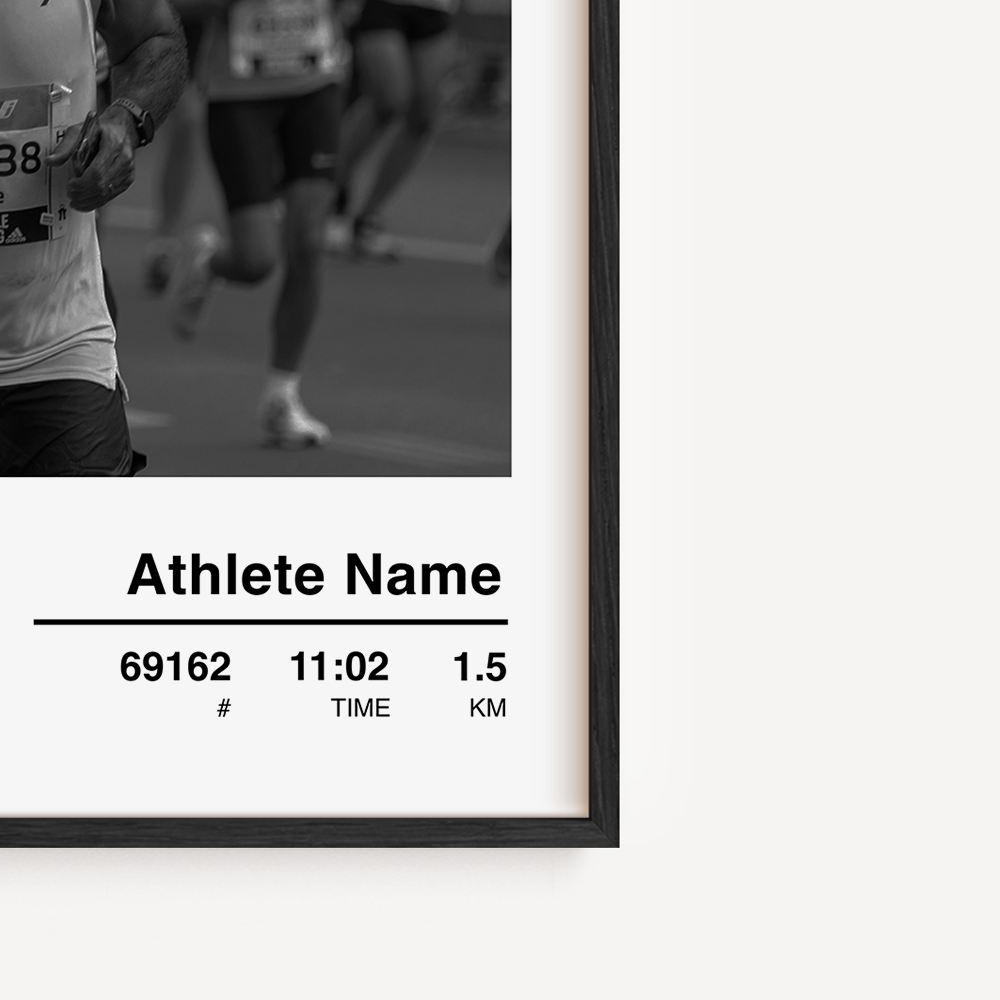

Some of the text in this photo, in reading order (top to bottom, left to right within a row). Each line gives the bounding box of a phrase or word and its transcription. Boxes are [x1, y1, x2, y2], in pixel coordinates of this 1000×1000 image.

[127, 552, 501, 596] Athlete Name
[120, 651, 507, 682] 69162 11:02 1.5
[330, 697, 391, 718] TIME
[470, 697, 506, 718] KM
